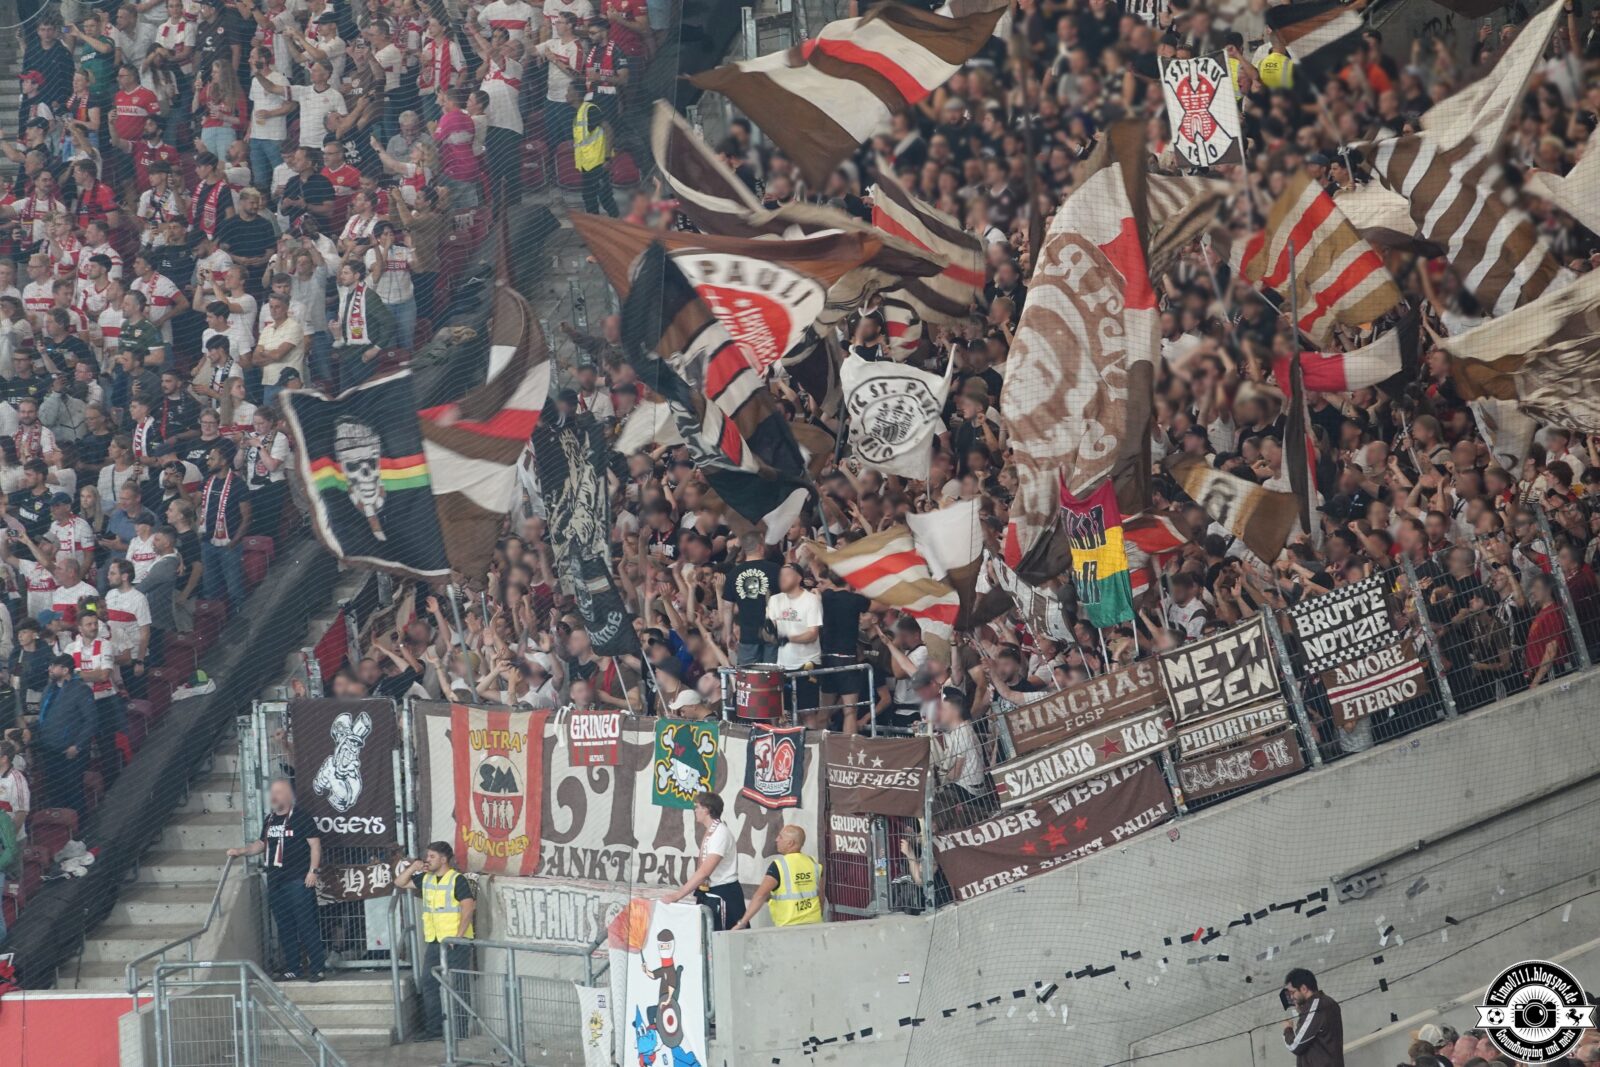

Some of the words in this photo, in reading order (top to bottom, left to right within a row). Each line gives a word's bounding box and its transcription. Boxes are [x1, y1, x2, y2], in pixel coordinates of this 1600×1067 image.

[696, 260, 815, 307] PAULI
[869, 382, 897, 398] ST.
[1296, 587, 1386, 637] BRUTTE
[1164, 625, 1261, 689] METT
[1302, 610, 1391, 660] NOTIZIE
[1336, 644, 1405, 685] AMORE
[1008, 662, 1155, 735] HINCHAS
[1174, 658, 1275, 721] CREW
[1343, 679, 1418, 721] ETERNO
[571, 713, 620, 739] GRINGO
[1065, 708, 1105, 732] FCSP
[1180, 705, 1287, 752] PRIORITAS
[1004, 742, 1096, 798] SZENARIO
[1120, 715, 1168, 754] KAOS
[831, 814, 870, 834] GRUPPO
[932, 808, 1042, 853] WILDER
[1110, 801, 1168, 842] PAULI
[835, 835, 867, 854] PAZZO
[795, 872, 812, 881] SDS
[502, 886, 600, 943] ENFANTS
